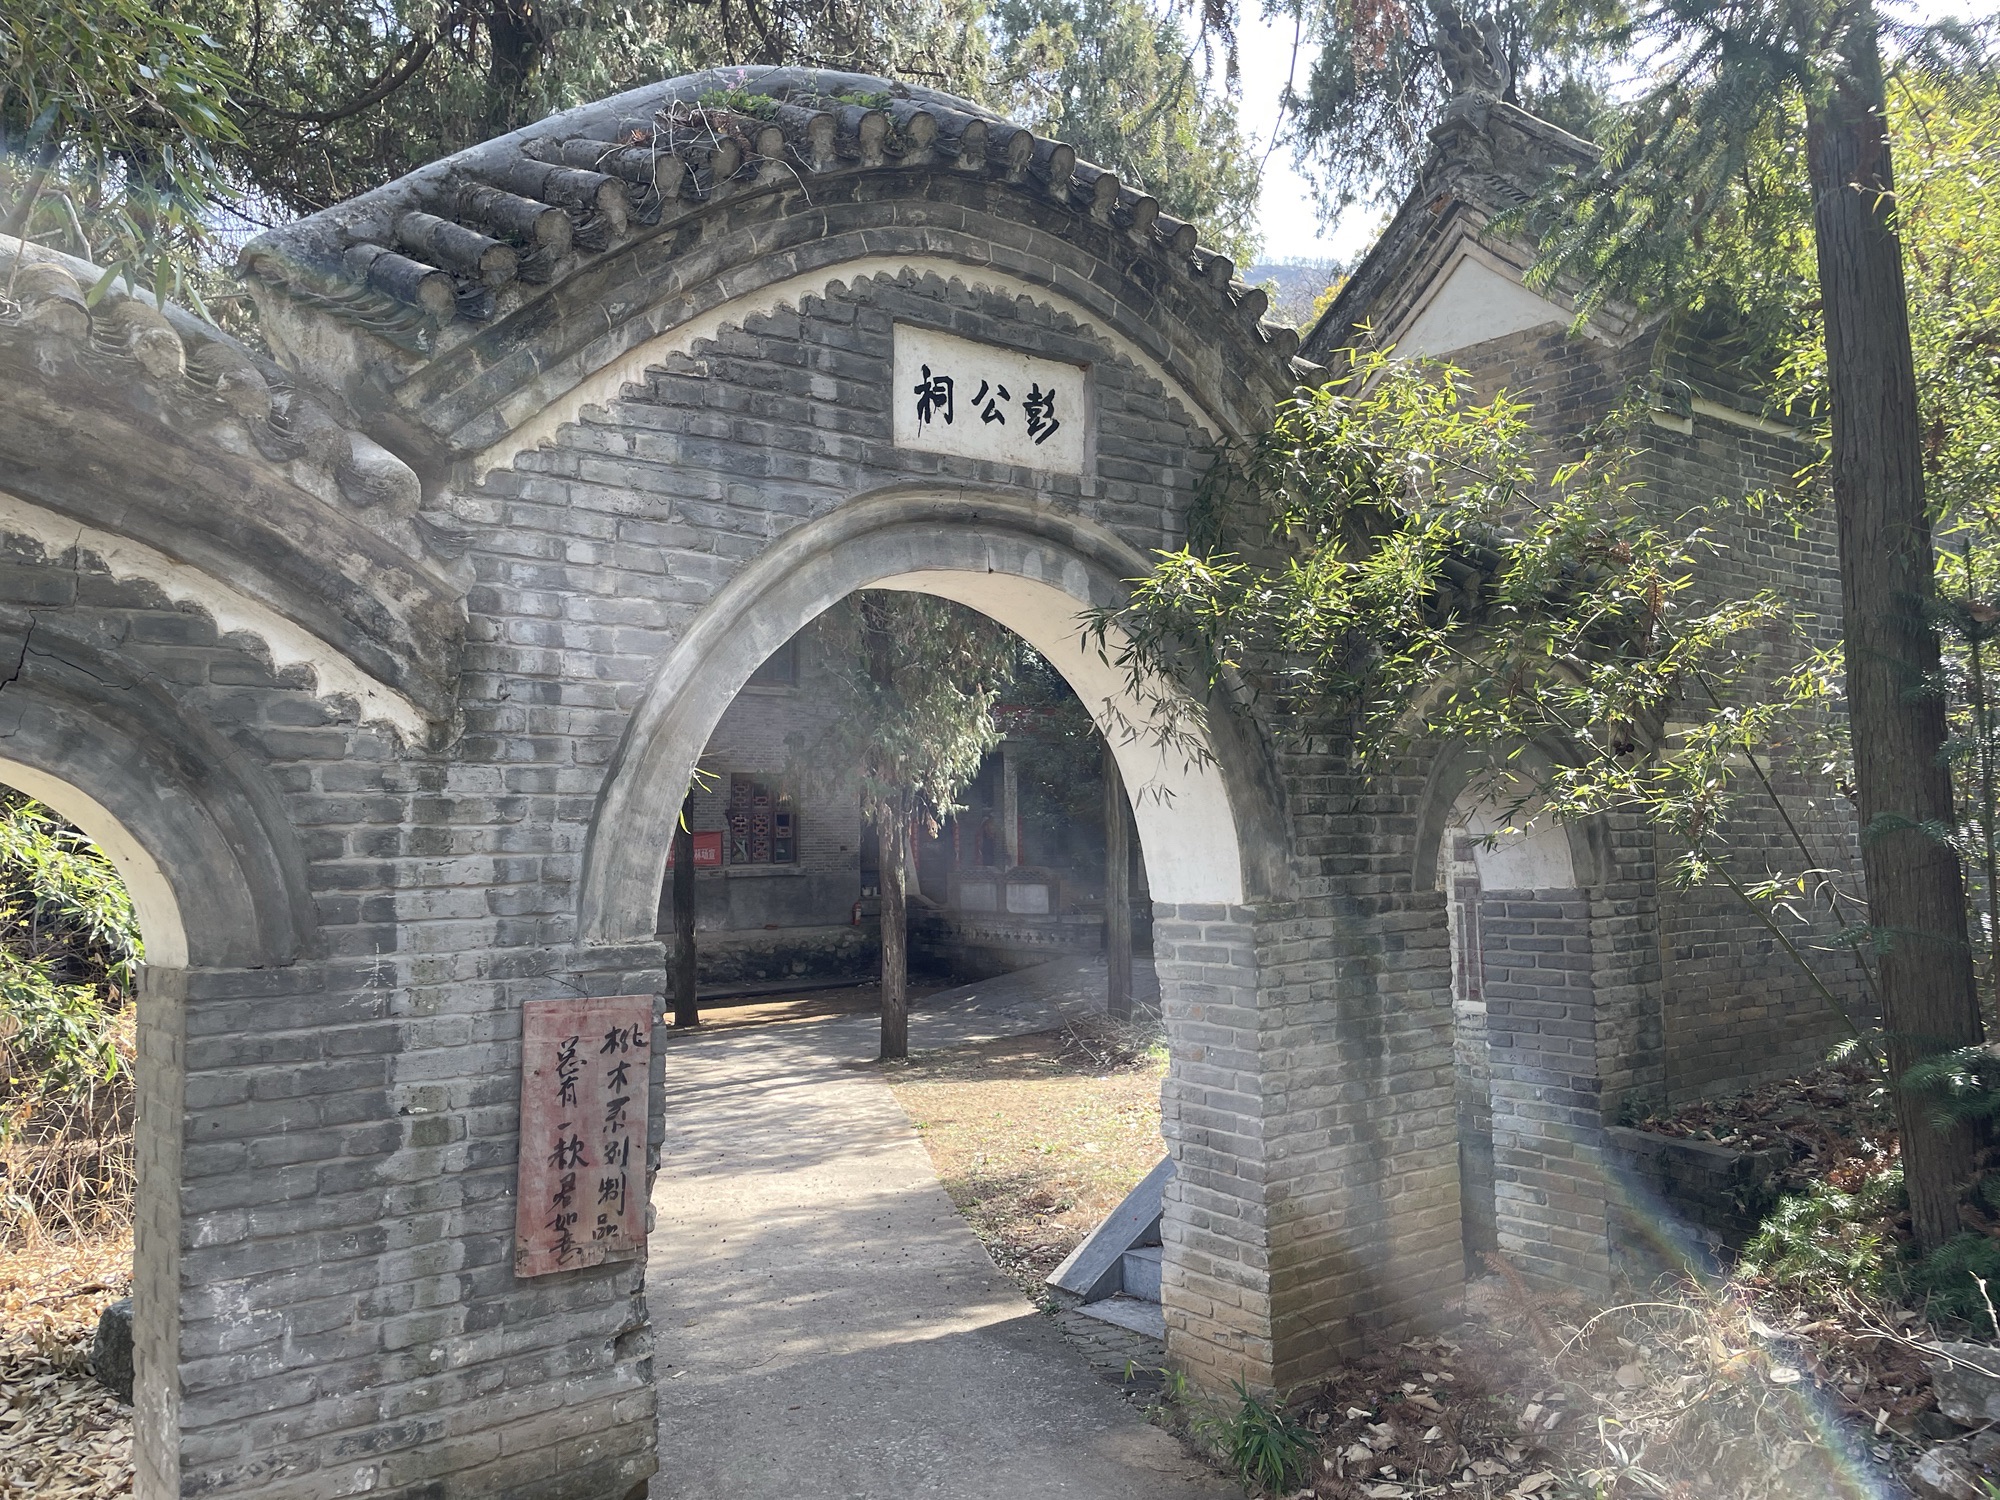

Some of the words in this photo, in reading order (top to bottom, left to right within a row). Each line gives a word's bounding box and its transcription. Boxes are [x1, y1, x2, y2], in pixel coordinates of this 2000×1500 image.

[914, 364, 1060, 446] 彭公祠
[592, 1022, 649, 1241] 桃木系列制品
